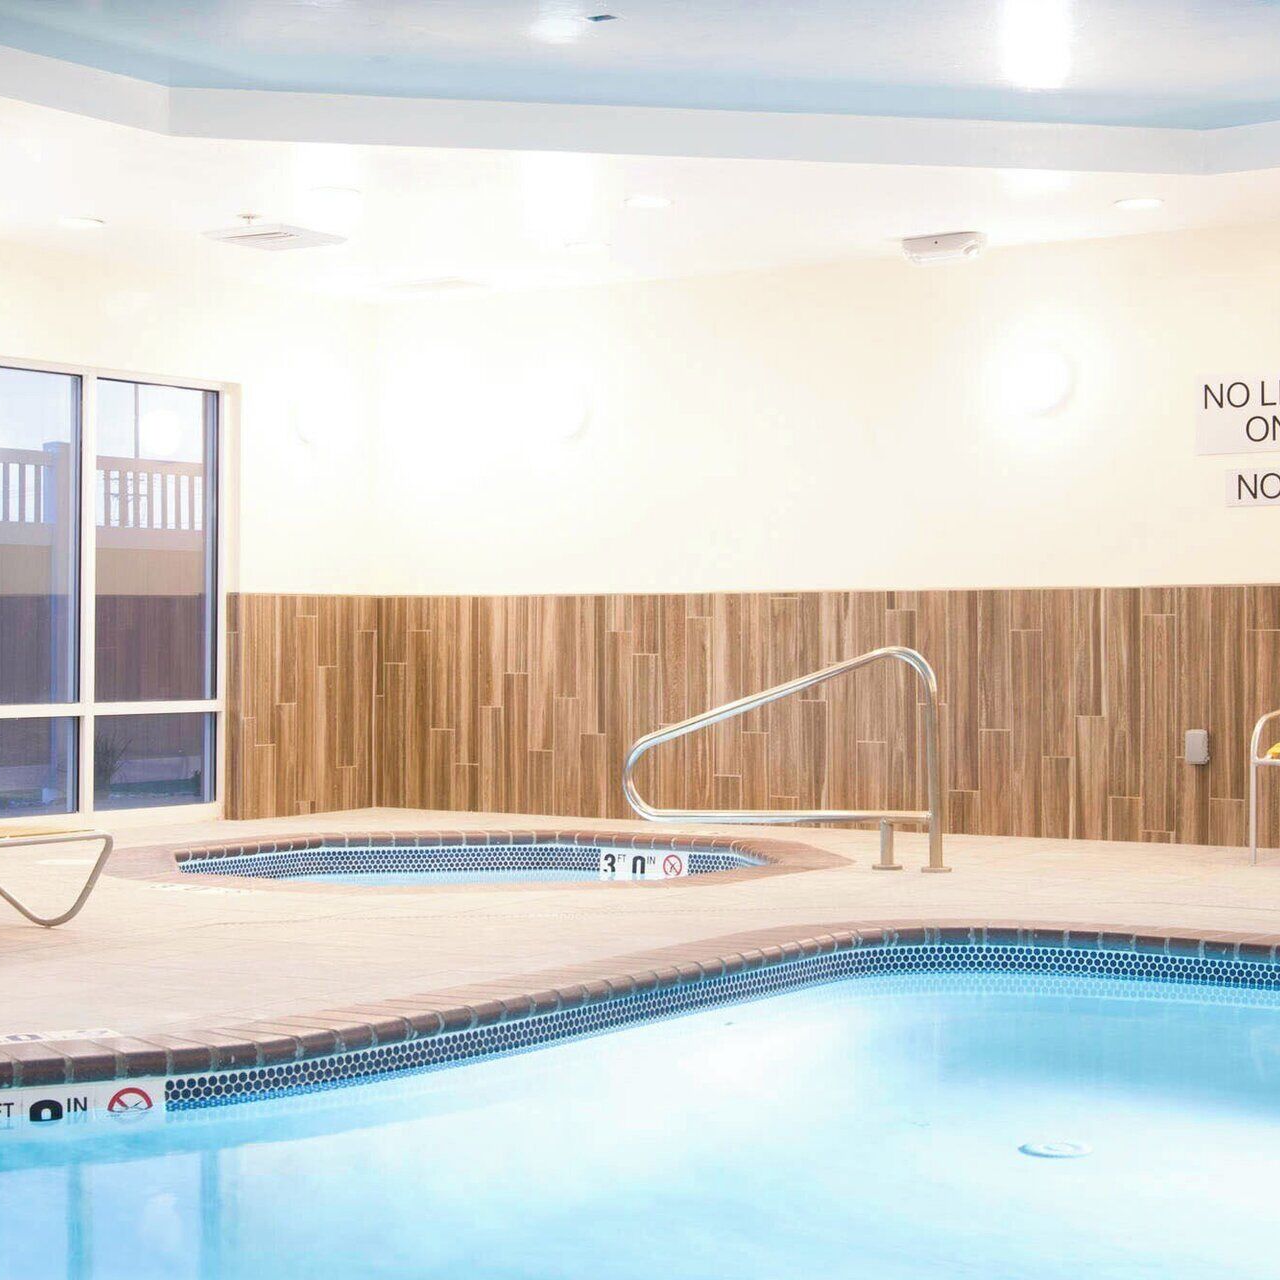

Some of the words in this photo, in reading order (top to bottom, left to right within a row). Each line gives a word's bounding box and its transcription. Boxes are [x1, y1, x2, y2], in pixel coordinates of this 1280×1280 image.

[1203, 381, 1250, 409] NO
[603, 853, 616, 873] 3
[618, 854, 626, 863] FT
[66, 1096, 88, 1113] IN
